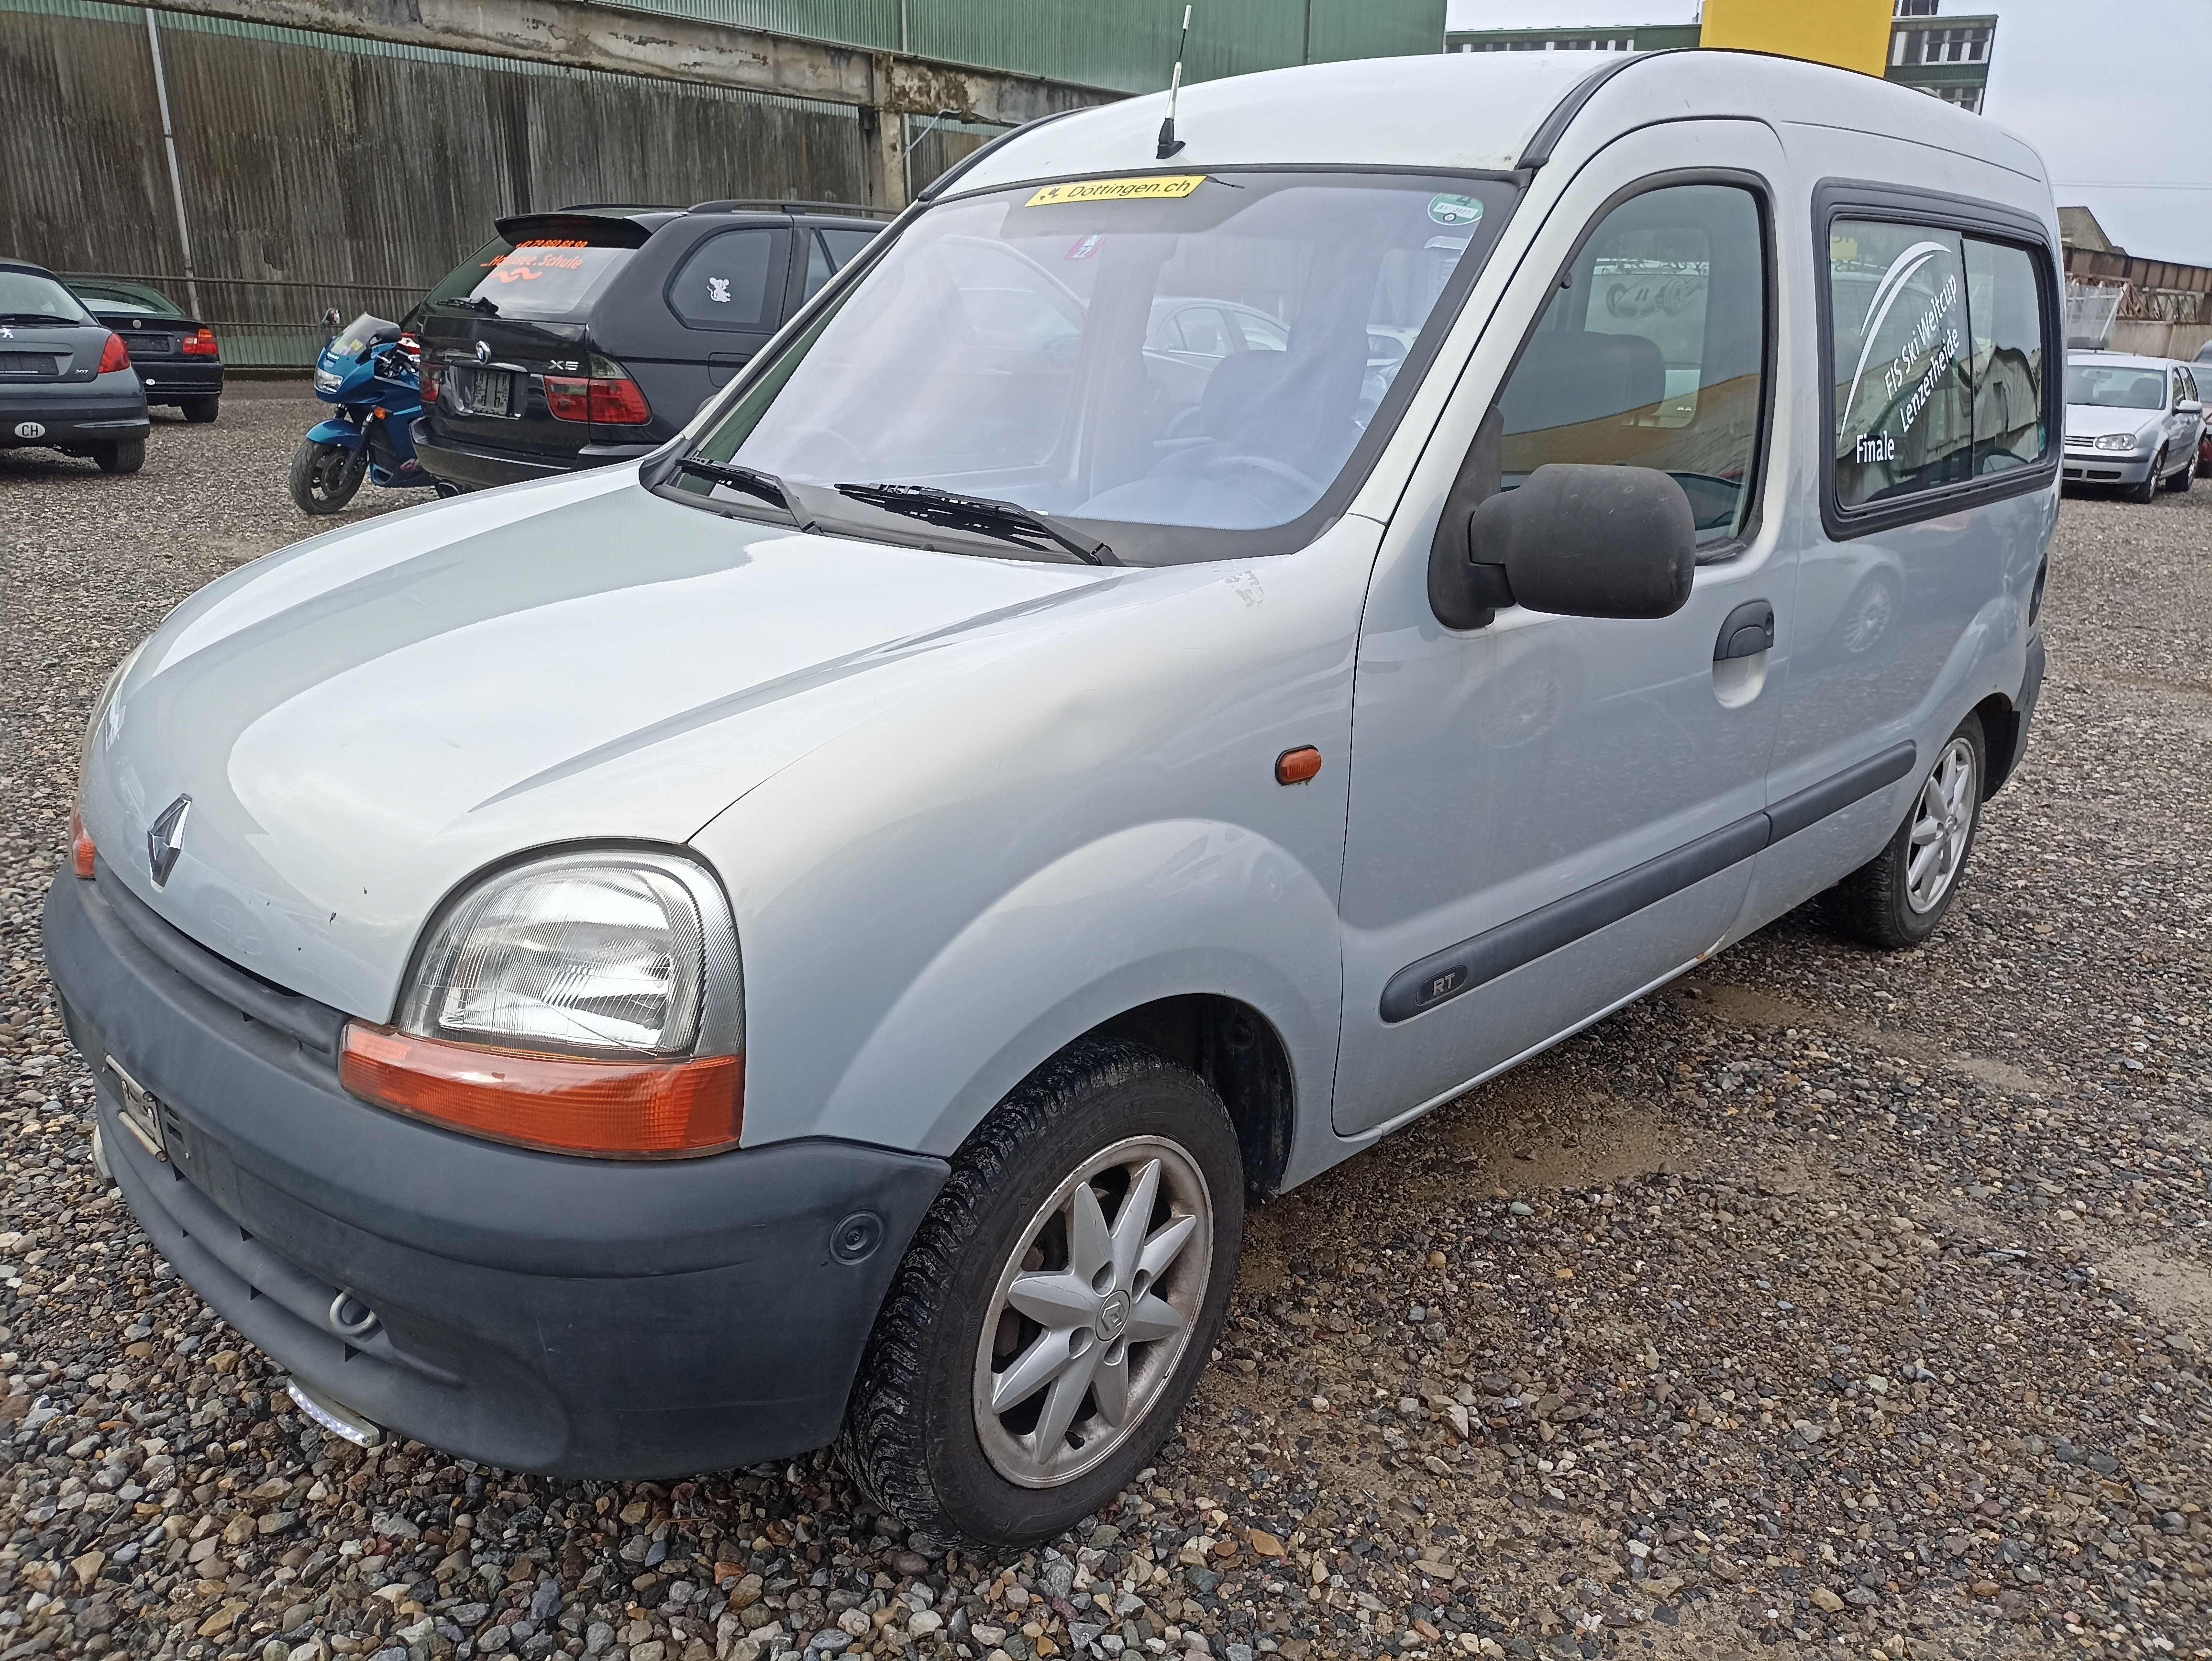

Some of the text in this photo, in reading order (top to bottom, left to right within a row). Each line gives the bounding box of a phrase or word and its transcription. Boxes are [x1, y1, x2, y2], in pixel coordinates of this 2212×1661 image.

[1067, 180, 1190, 197] Döttingen.ch
[1885, 274, 1957, 400] FIS Ski Weltcup
[548, 360, 579, 370] X5
[1900, 329, 1959, 432] Lenzerheide
[22, 424, 38, 437] CH
[1857, 430, 1894, 464] Finale
[1433, 973, 1455, 996] RT
